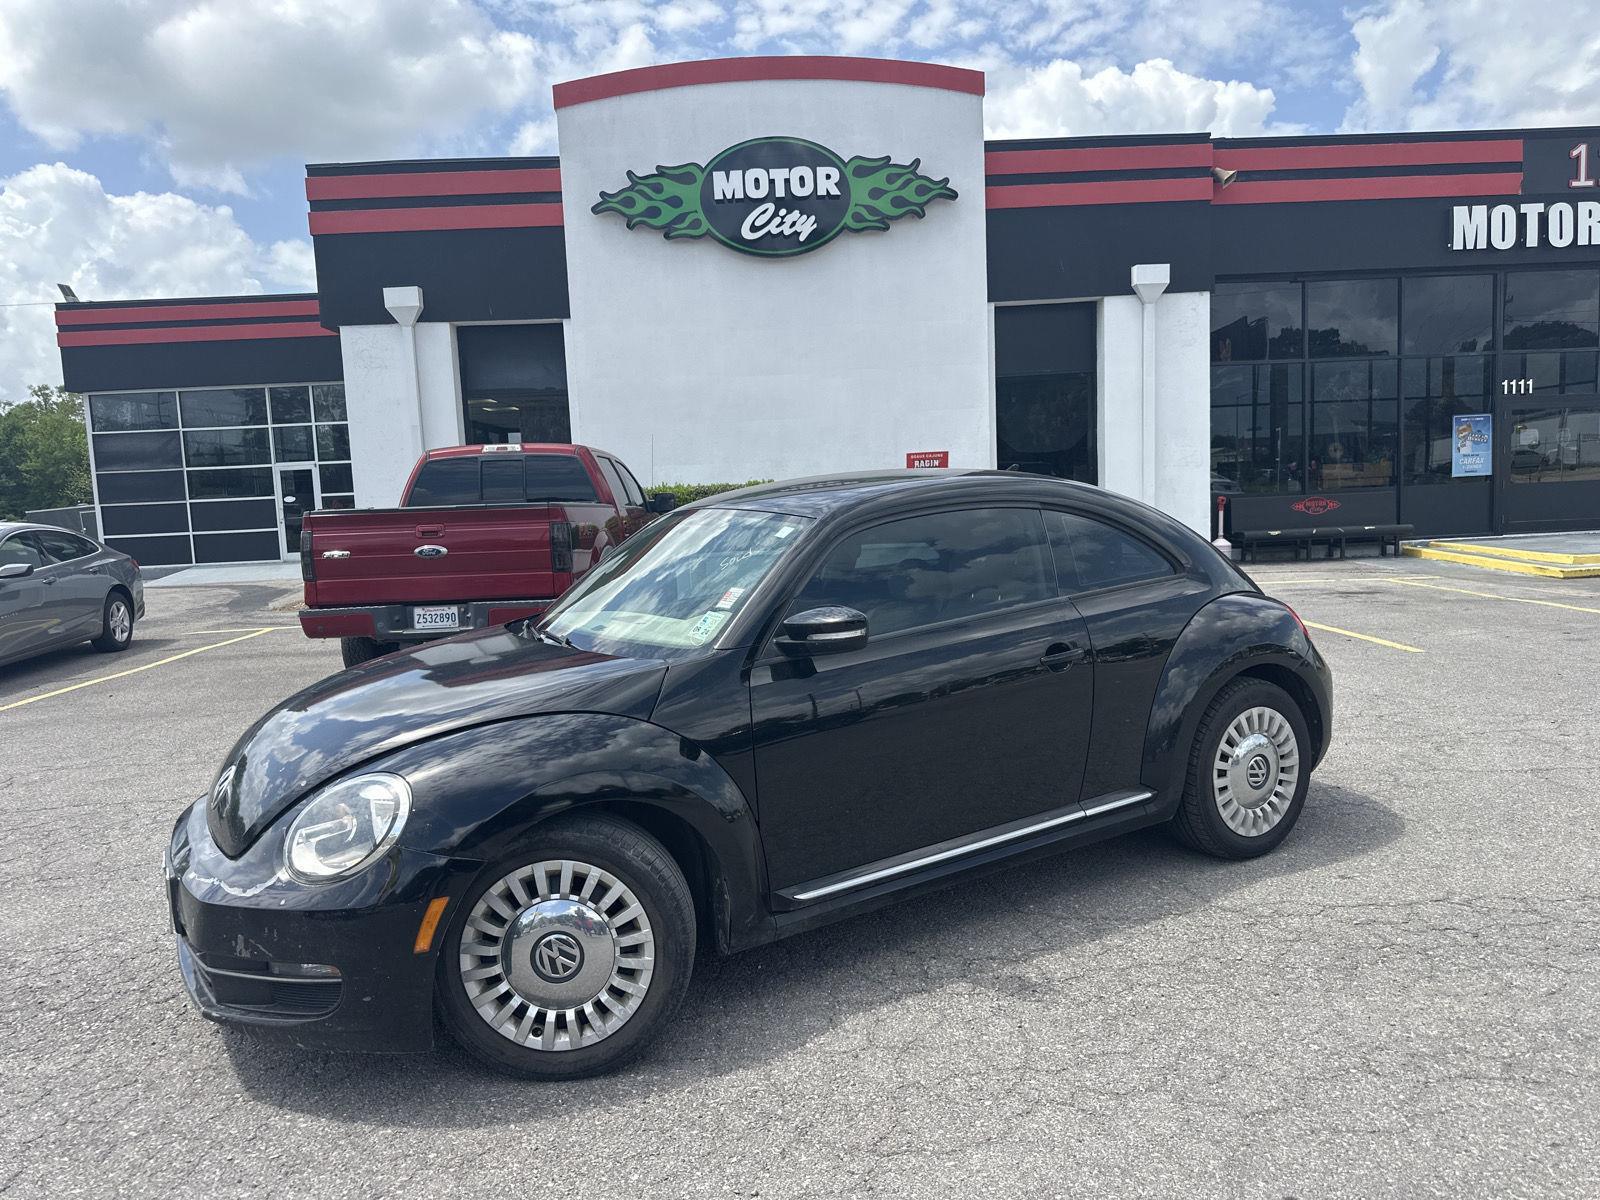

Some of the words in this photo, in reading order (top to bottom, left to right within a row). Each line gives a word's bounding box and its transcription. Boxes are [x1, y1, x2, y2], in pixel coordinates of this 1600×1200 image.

[712, 166, 841, 200] MOTOR
[1569, 143, 1600, 187] 1
[740, 202, 818, 242] City
[1452, 201, 1600, 250] MOTOR
[1501, 378, 1534, 395] 1111
[416, 612, 457, 624] Z532890
